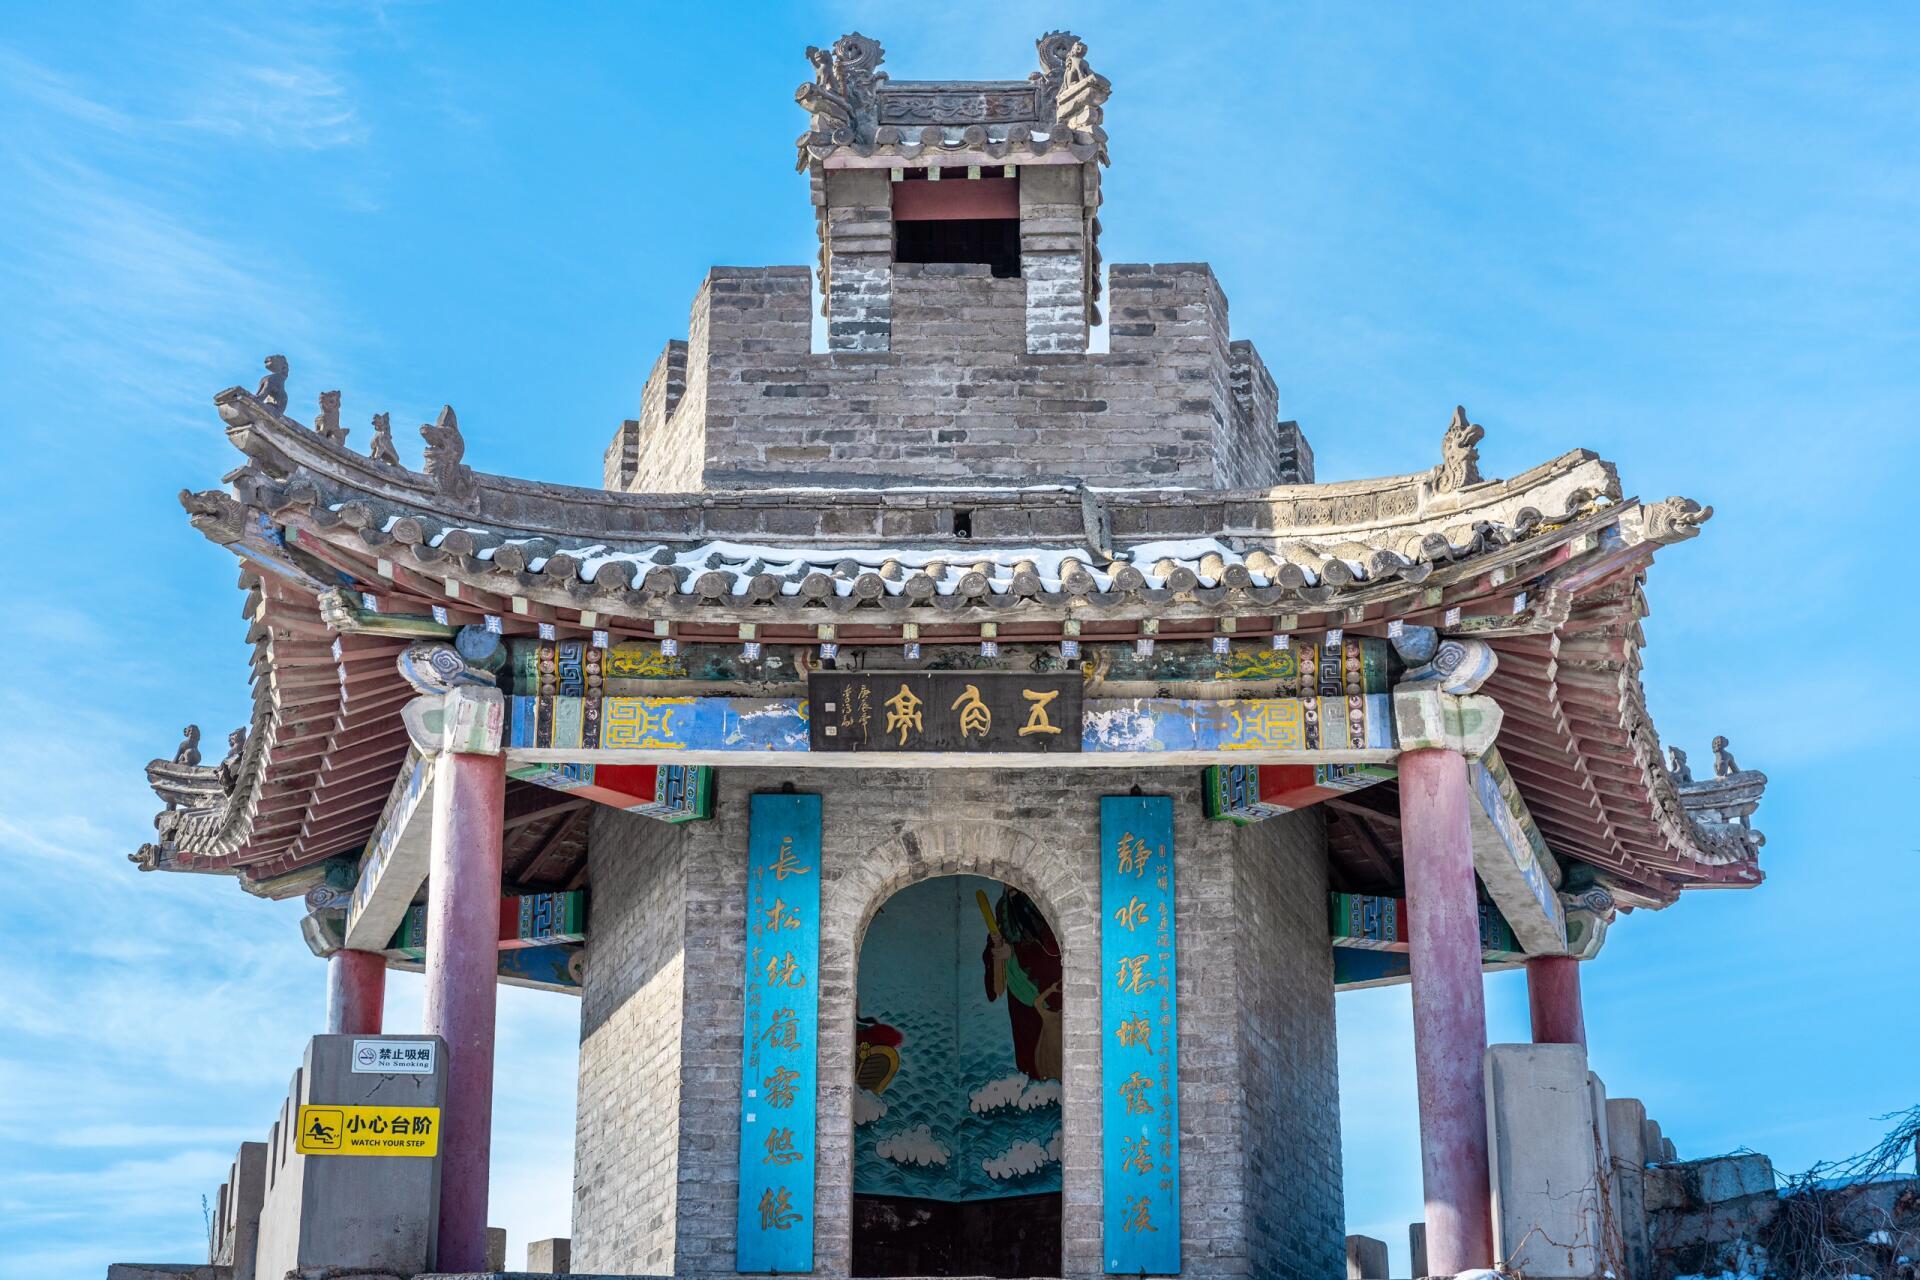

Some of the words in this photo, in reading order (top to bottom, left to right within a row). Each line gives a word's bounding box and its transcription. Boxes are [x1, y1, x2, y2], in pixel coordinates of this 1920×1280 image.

[379, 1048, 430, 1060] 禁止吸烟
[392, 1060, 429, 1068] Smoking
[346, 1114, 432, 1135] 小心台阶
[382, 1139, 405, 1147] YOUR
